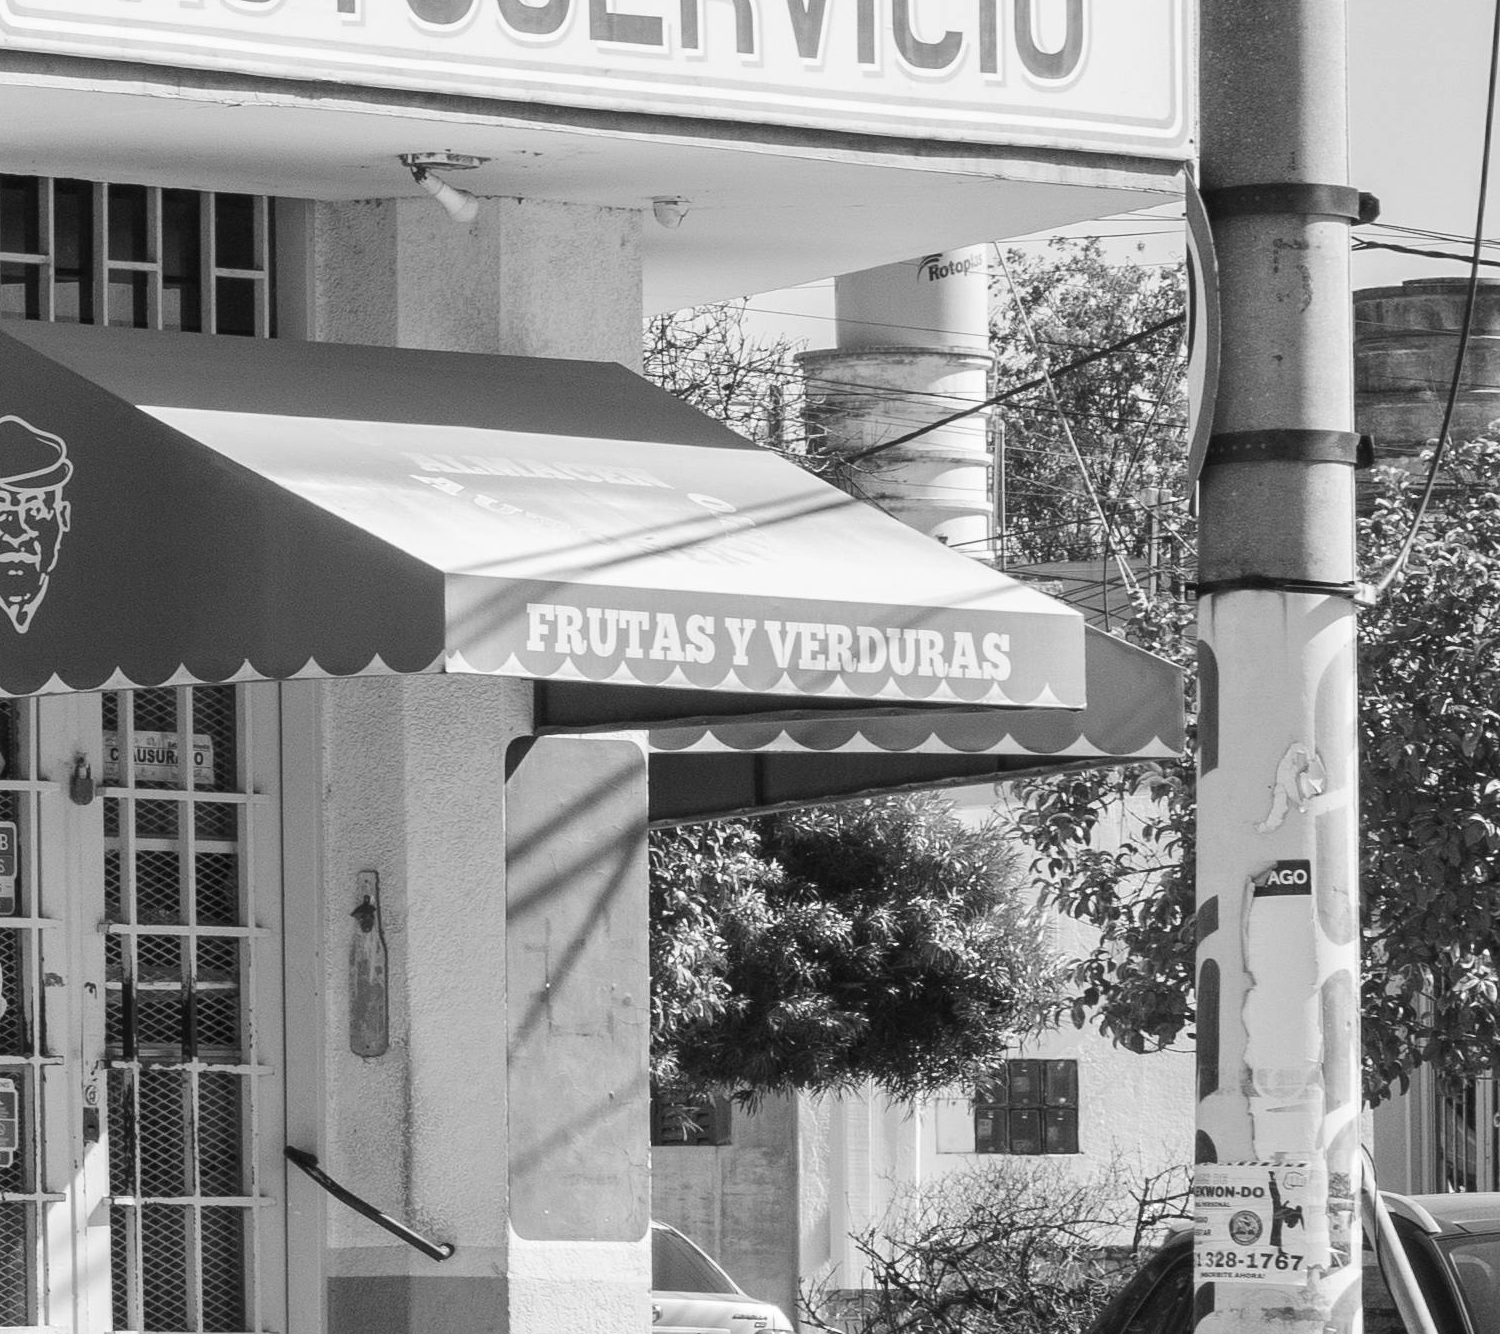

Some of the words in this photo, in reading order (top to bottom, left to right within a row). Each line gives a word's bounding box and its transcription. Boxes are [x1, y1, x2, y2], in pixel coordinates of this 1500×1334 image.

[928, 253, 983, 282] Rotoplas
[525, 602, 716, 664] FRUTAS
[725, 617, 757, 667] Y
[763, 619, 1013, 682] VERDURAS
[109, 746, 205, 766] CUSURO
[1266, 868, 1308, 886] AGO
[1205, 1250, 1304, 1271] 328-1767
